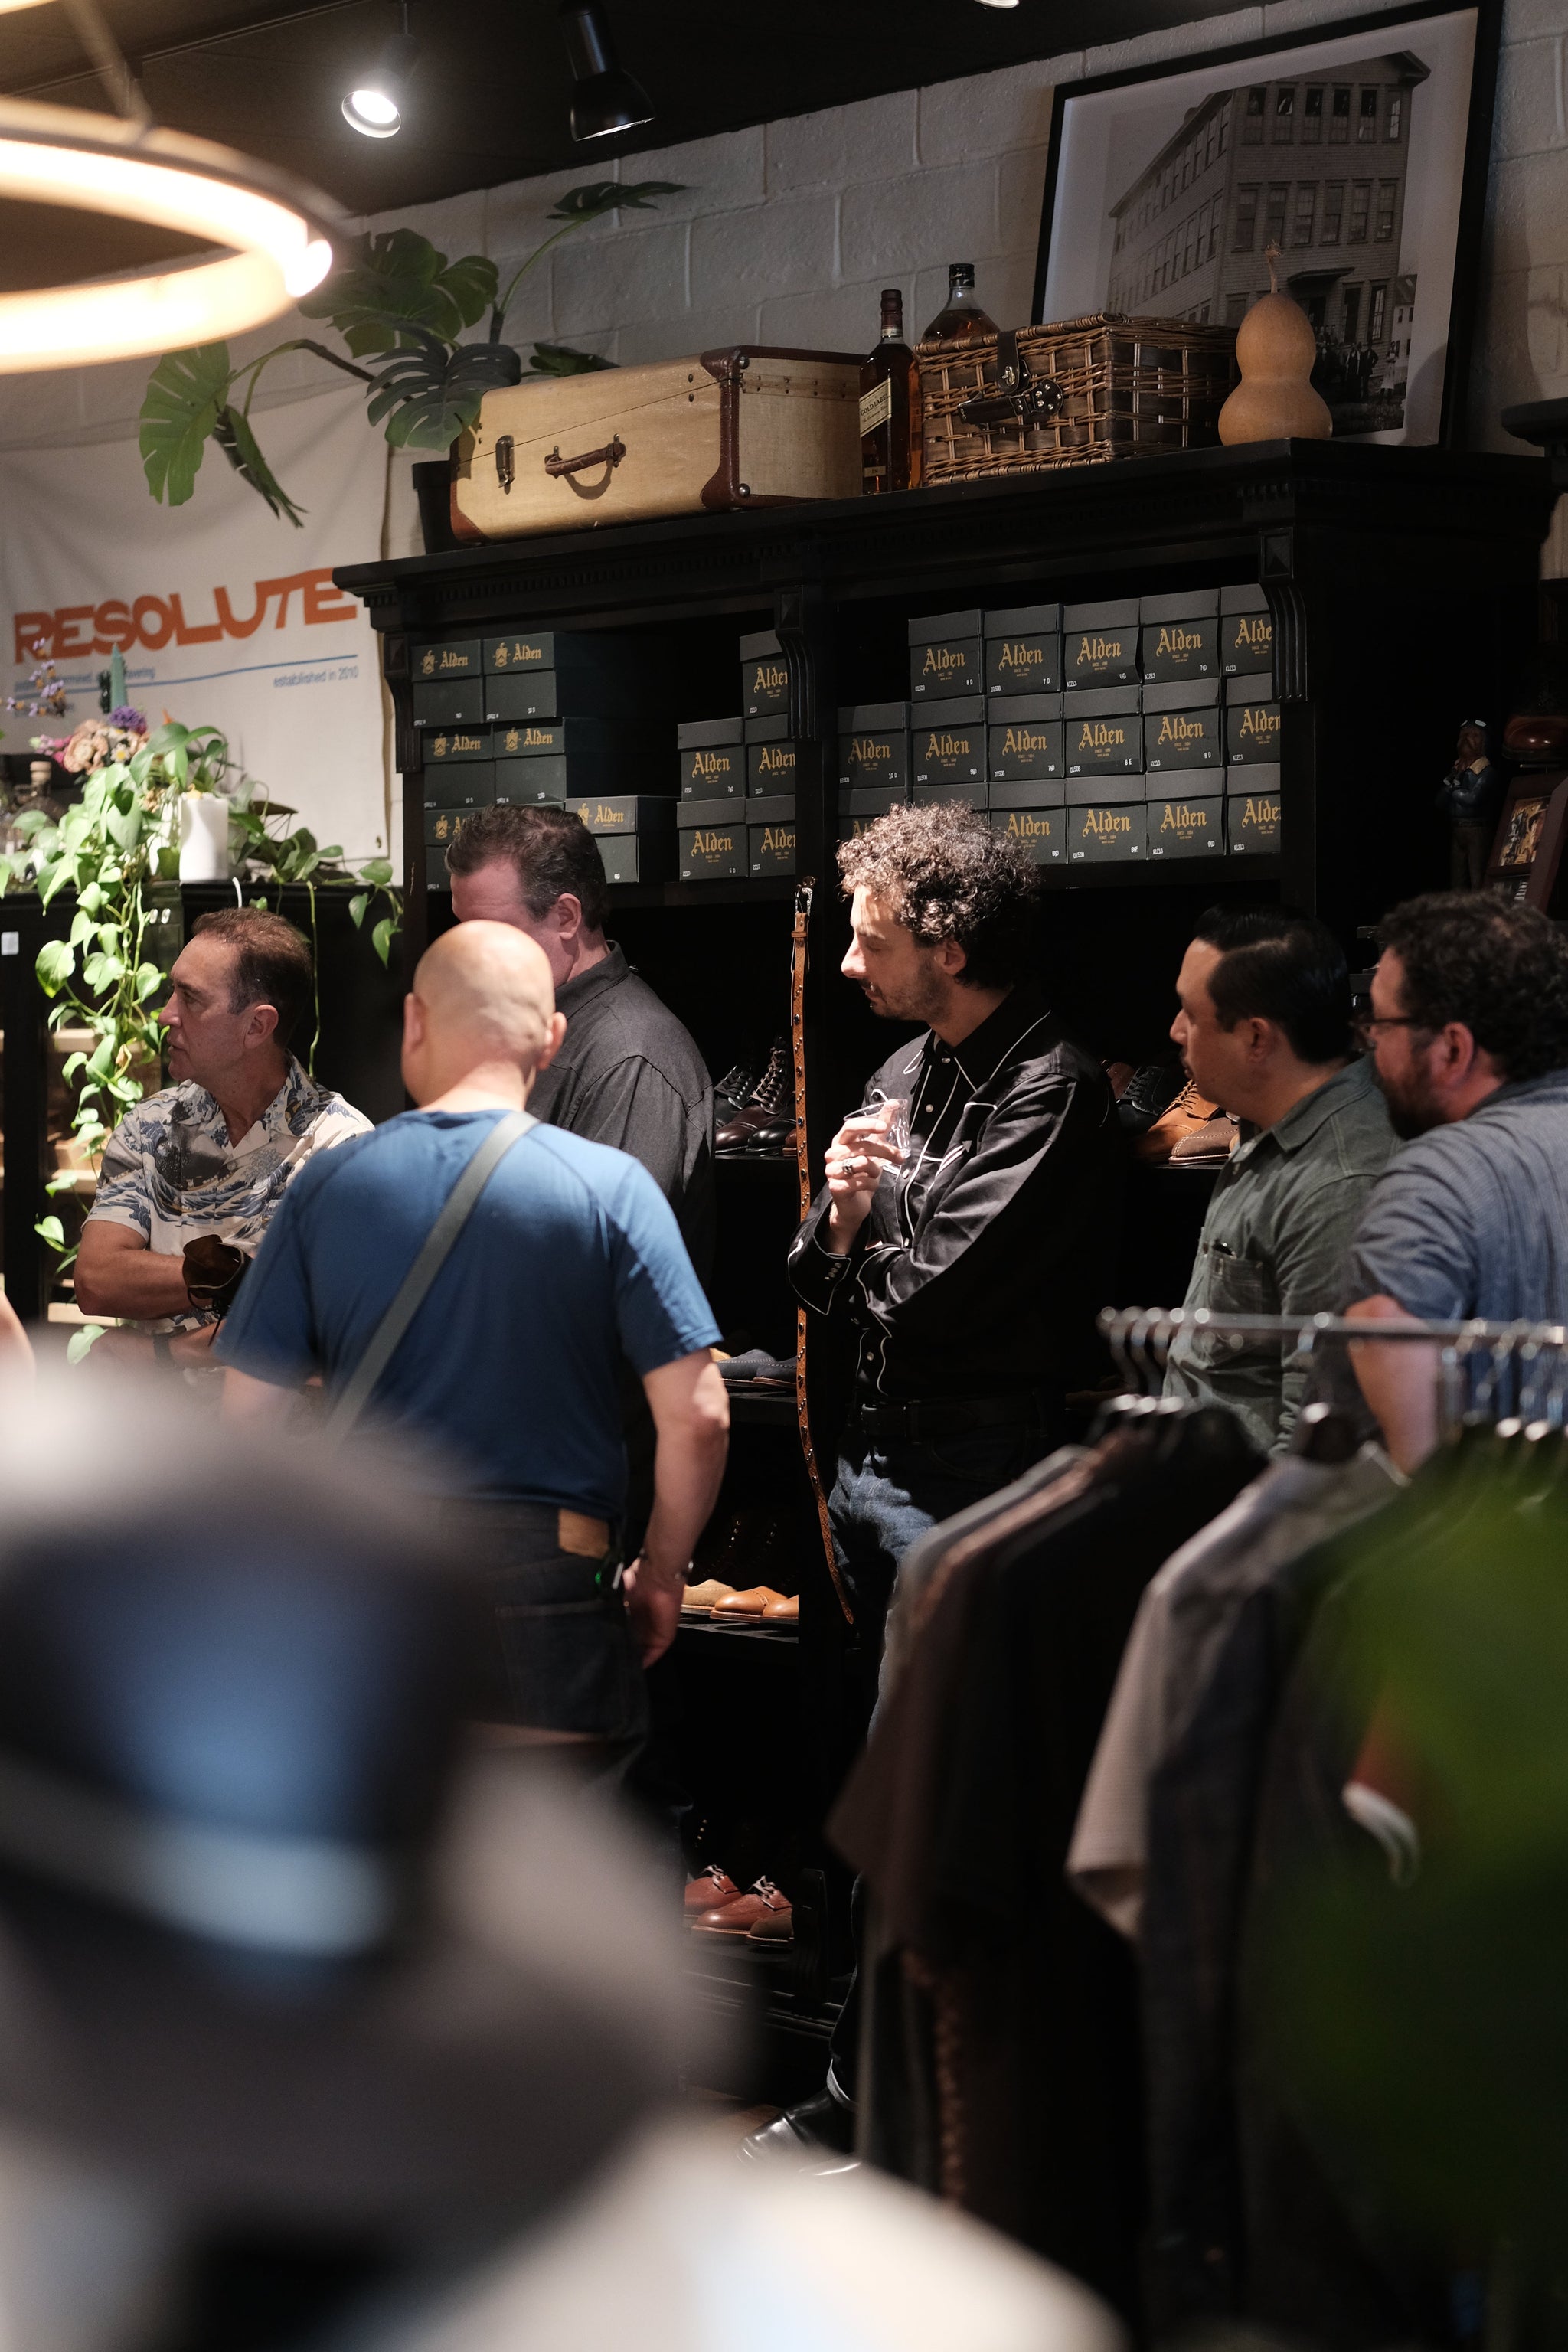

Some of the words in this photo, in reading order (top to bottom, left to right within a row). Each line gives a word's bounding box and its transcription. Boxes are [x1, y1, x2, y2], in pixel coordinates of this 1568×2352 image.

[860, 403, 874, 416] GOLD
[14, 567, 358, 665] RESOLUTE
[1155, 628, 1202, 657] Alden
[1234, 618, 1272, 648] Alde
[439, 650, 469, 671] Alden
[512, 643, 542, 663] Alden
[923, 648, 965, 676] Alden
[998, 643, 1043, 671] Alden
[1076, 637, 1122, 665] Alden
[273, 671, 327, 688] established
[338, 665, 359, 681] 2010
[451, 734, 481, 753] Alden
[523, 728, 553, 748] Alden
[1001, 728, 1047, 756] Alden
[1078, 722, 1125, 751] Alden
[1158, 716, 1204, 745] Alden
[759, 747, 796, 773] Alden
[848, 738, 891, 765] Alden
[926, 733, 971, 760] Alden
[691, 752, 730, 778] Alden
[594, 805, 624, 824] Alden
[1004, 813, 1050, 839] Alden
[1082, 808, 1131, 837] Alden
[1160, 804, 1207, 833] Alden
[1241, 798, 1281, 828] Alde
[691, 831, 733, 857] Alden
